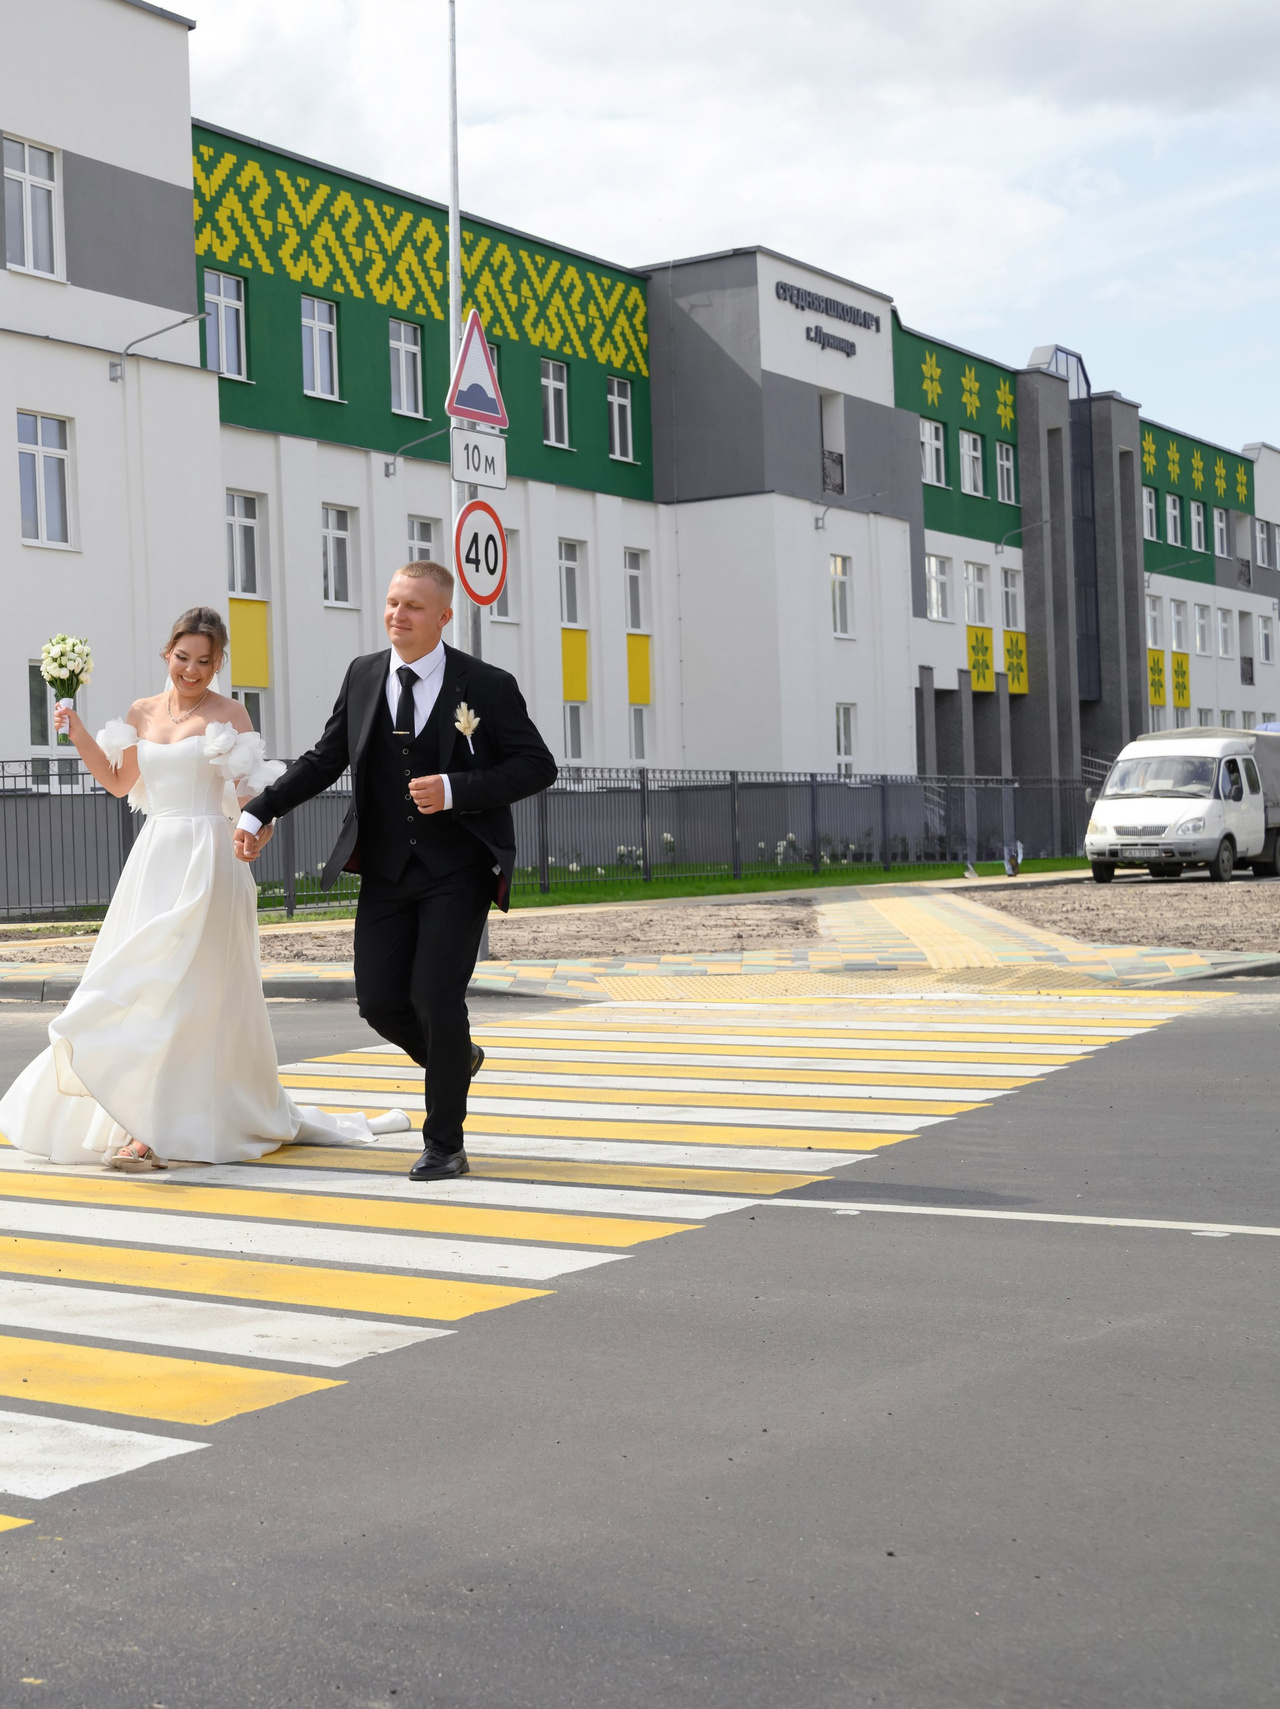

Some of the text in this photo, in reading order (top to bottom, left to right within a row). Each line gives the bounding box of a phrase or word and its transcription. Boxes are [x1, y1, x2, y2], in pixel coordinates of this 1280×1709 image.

[775, 281, 825, 312] СРЕДНЯЯ
[825, 297, 863, 327] ШКОЛА
[464, 443, 481, 472] 10
[465, 531, 499, 576] 40
